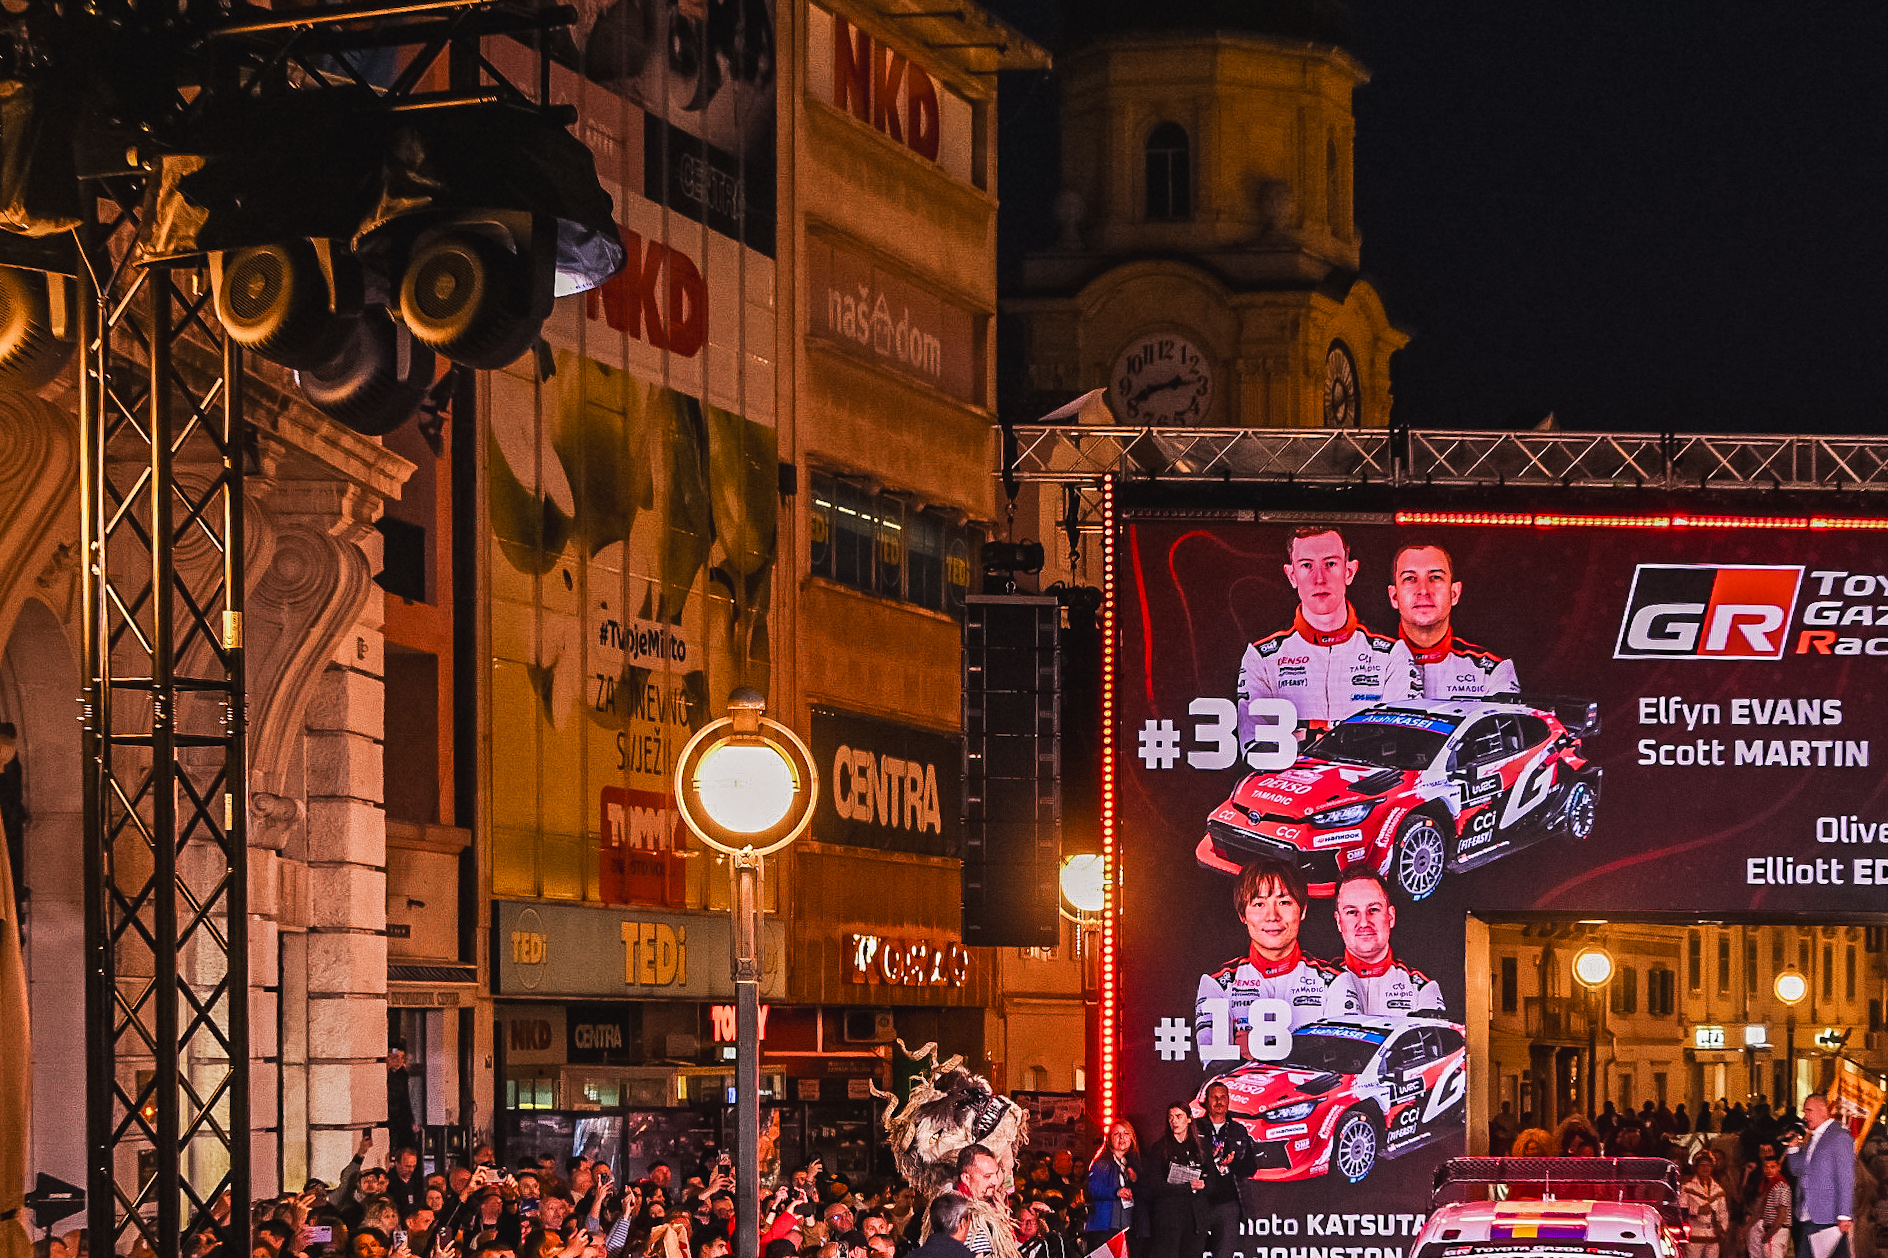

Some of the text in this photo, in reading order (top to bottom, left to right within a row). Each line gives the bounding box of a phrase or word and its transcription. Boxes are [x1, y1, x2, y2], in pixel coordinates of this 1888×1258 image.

[834, 10, 940, 163] NKD
[1627, 603, 1785, 652] GR
[1277, 656, 1310, 666] DENSO
[1638, 697, 1843, 731] Elfyn EVANS
[1138, 698, 1298, 770] #33
[1638, 739, 1869, 768] Scott MARTIN
[833, 744, 942, 835] CENTRA
[1251, 790, 1293, 805] TAMADIC
[1258, 778, 1312, 794] DENSO
[1746, 858, 1844, 885] Elliott
[512, 930, 547, 965] TEDi
[621, 921, 687, 986] TEDi
[574, 1023, 622, 1049] CENTRA
[711, 1004, 768, 1043] TOY
[1154, 998, 1293, 1061] #18
